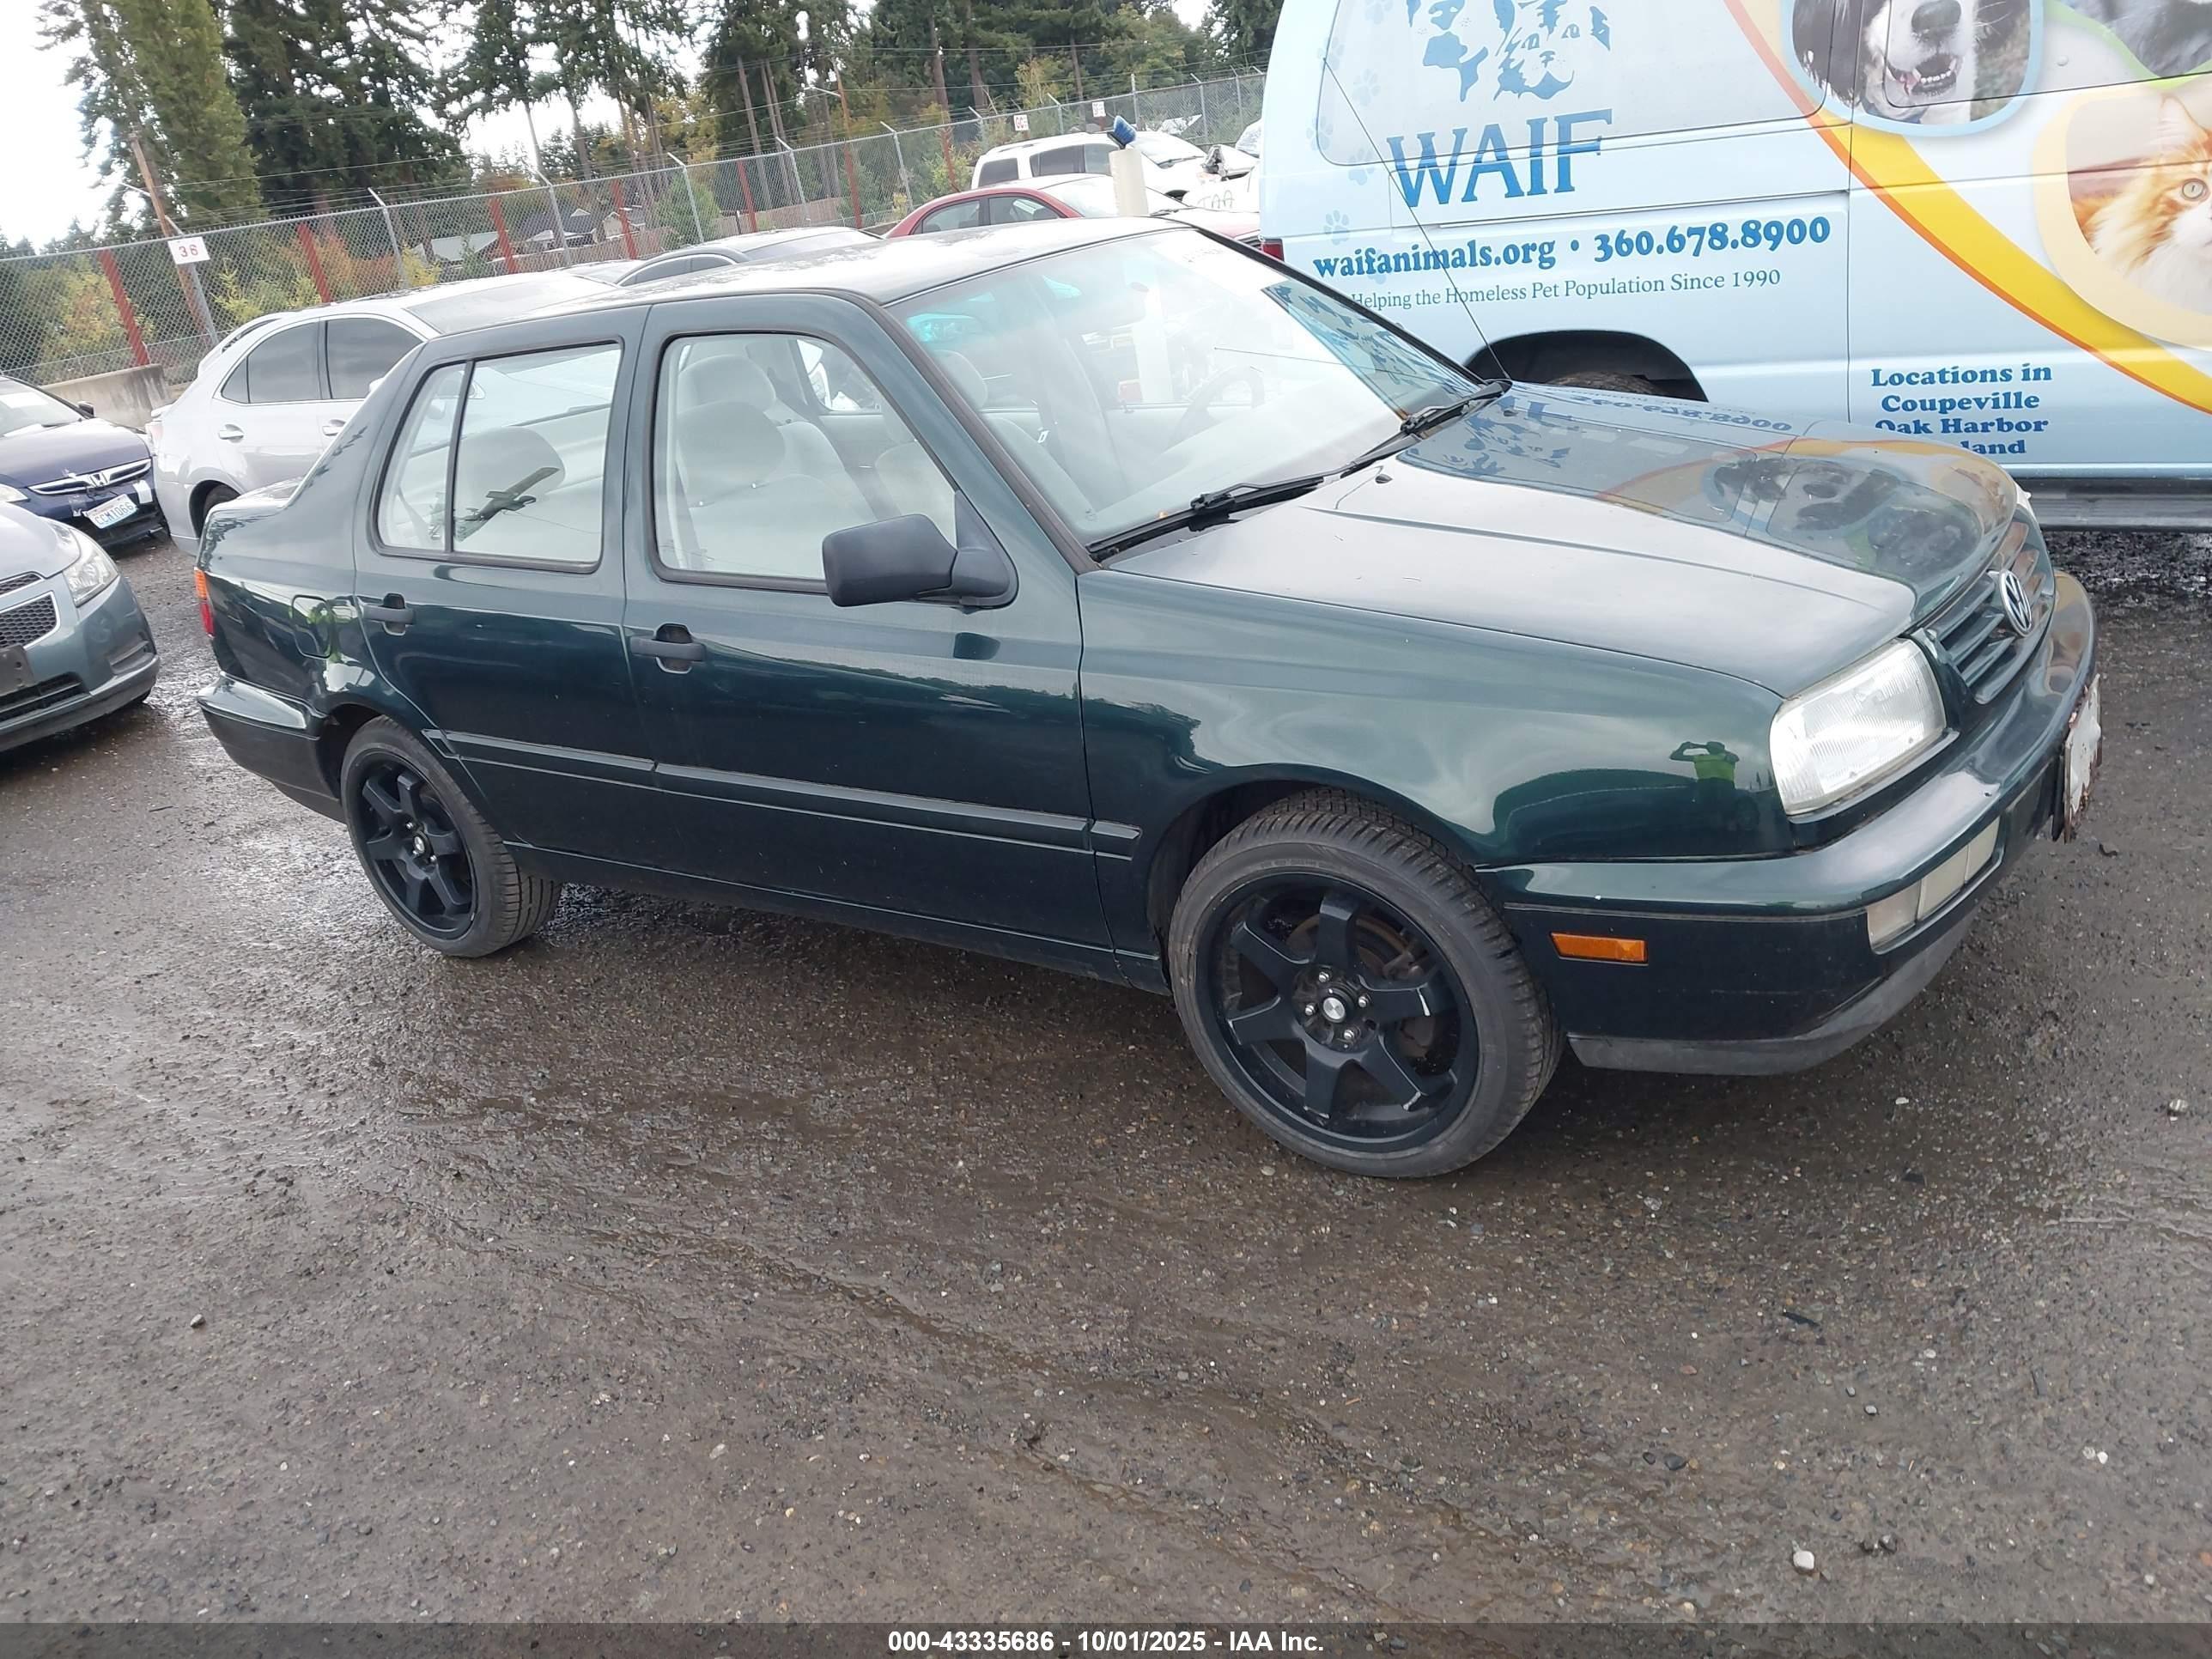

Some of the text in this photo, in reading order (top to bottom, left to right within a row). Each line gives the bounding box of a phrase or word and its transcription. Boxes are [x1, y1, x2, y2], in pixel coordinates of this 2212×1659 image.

[1386, 108, 1612, 207] WAIF
[179, 244, 198, 258] 36
[1313, 240, 1556, 277] waifanimals.org
[1594, 216, 1830, 263] 360.678.8900
[1352, 269, 1781, 311] Helping the Homeless Pet Population Since 1990
[1871, 362, 2052, 386] Locations in
[1881, 391, 2040, 415] Coupeville
[1941, 417, 2049, 434] Harbor
[1960, 440, 2027, 455] land
